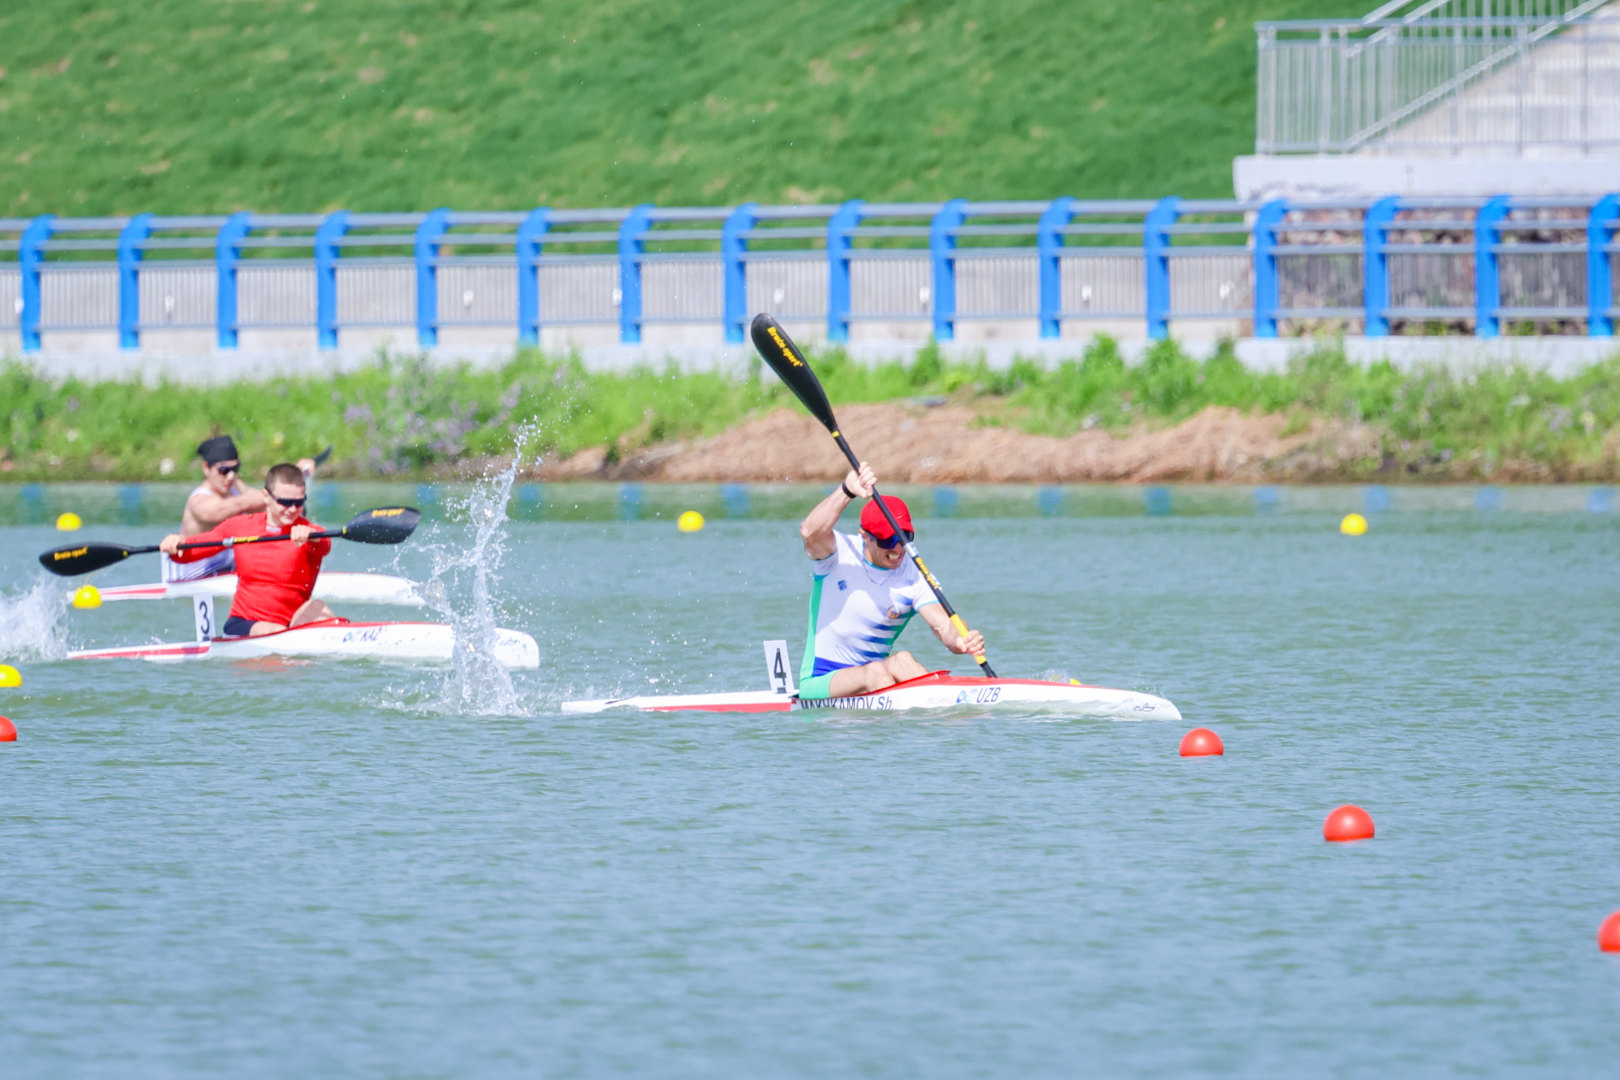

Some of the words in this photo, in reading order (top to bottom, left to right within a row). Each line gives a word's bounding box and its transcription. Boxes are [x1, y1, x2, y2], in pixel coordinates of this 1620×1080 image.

[199, 601, 210, 634] 3
[774, 648, 787, 686] 4
[976, 686, 1001, 703] UZB
